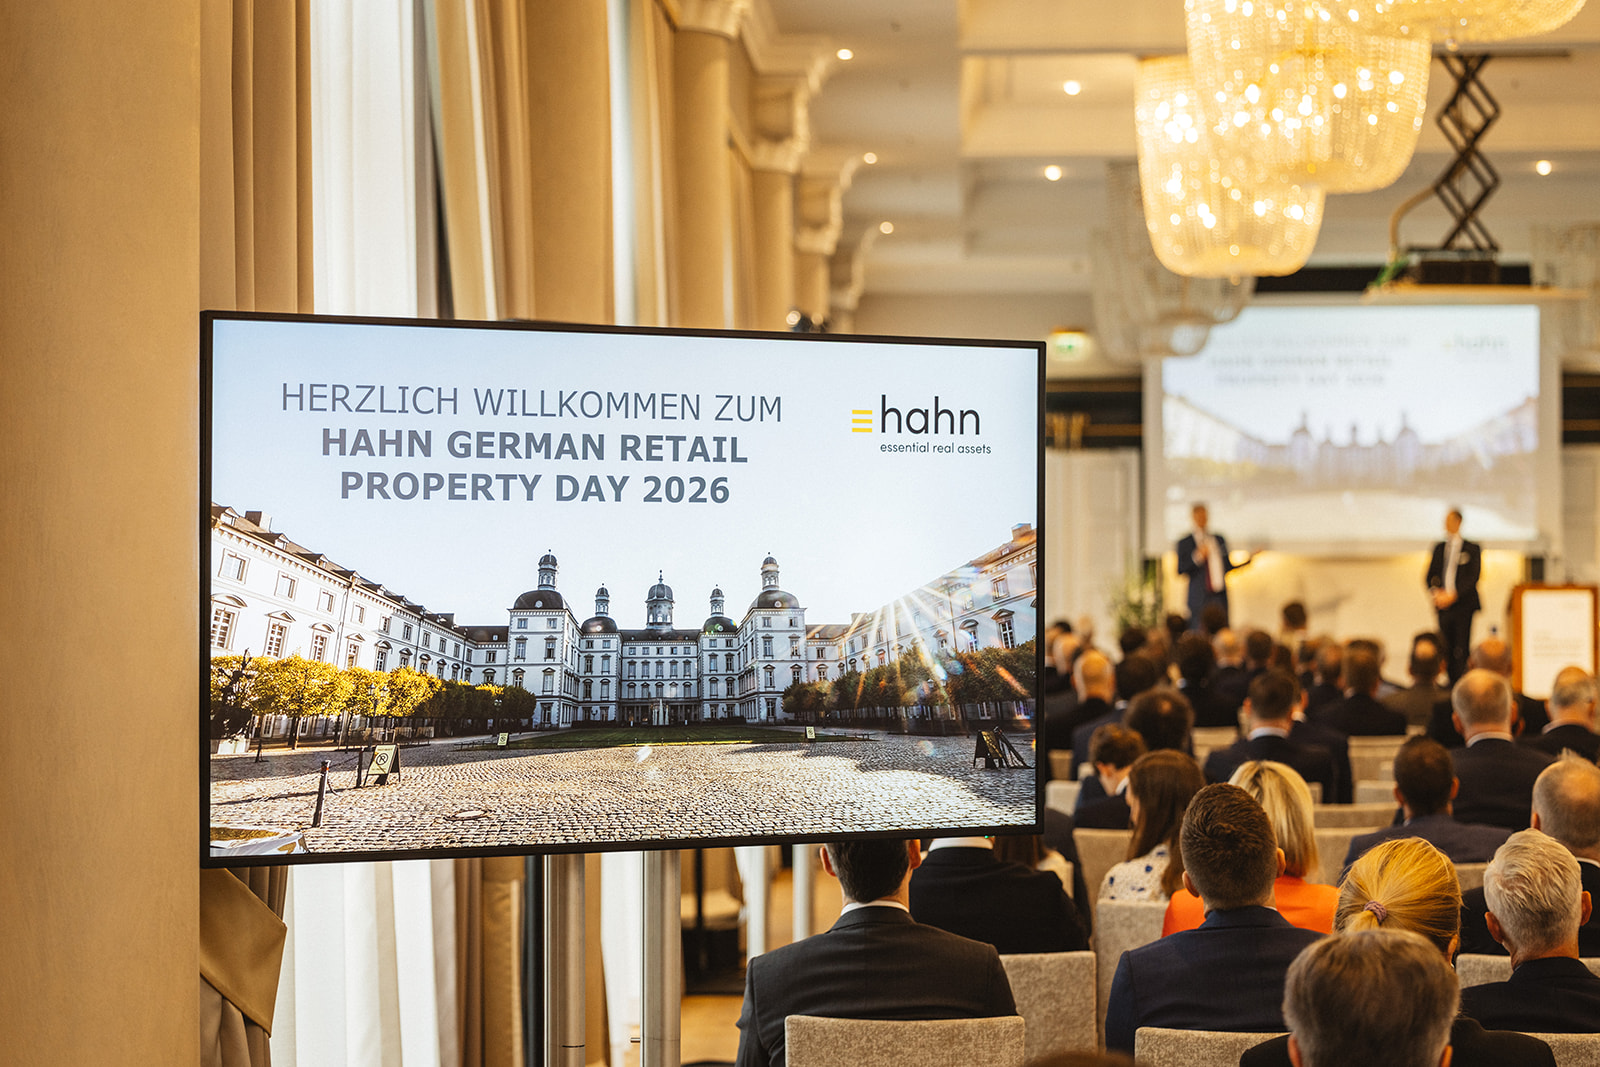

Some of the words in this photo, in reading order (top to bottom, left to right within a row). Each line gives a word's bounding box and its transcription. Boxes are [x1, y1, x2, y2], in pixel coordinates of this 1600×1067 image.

[282, 382, 458, 415] HERZLICH
[473, 388, 700, 421] WILLKOMMEN
[714, 394, 782, 423] ZUM
[880, 394, 980, 435] hahn
[322, 428, 432, 458] HAHN
[447, 431, 605, 461] GERMAN
[620, 434, 748, 463] RETAIL
[880, 442, 929, 453] essential
[932, 443, 954, 453] real
[957, 444, 992, 454] assets
[341, 471, 542, 501] PROPERTY
[555, 474, 630, 502] DAY
[643, 475, 730, 503] 2026
